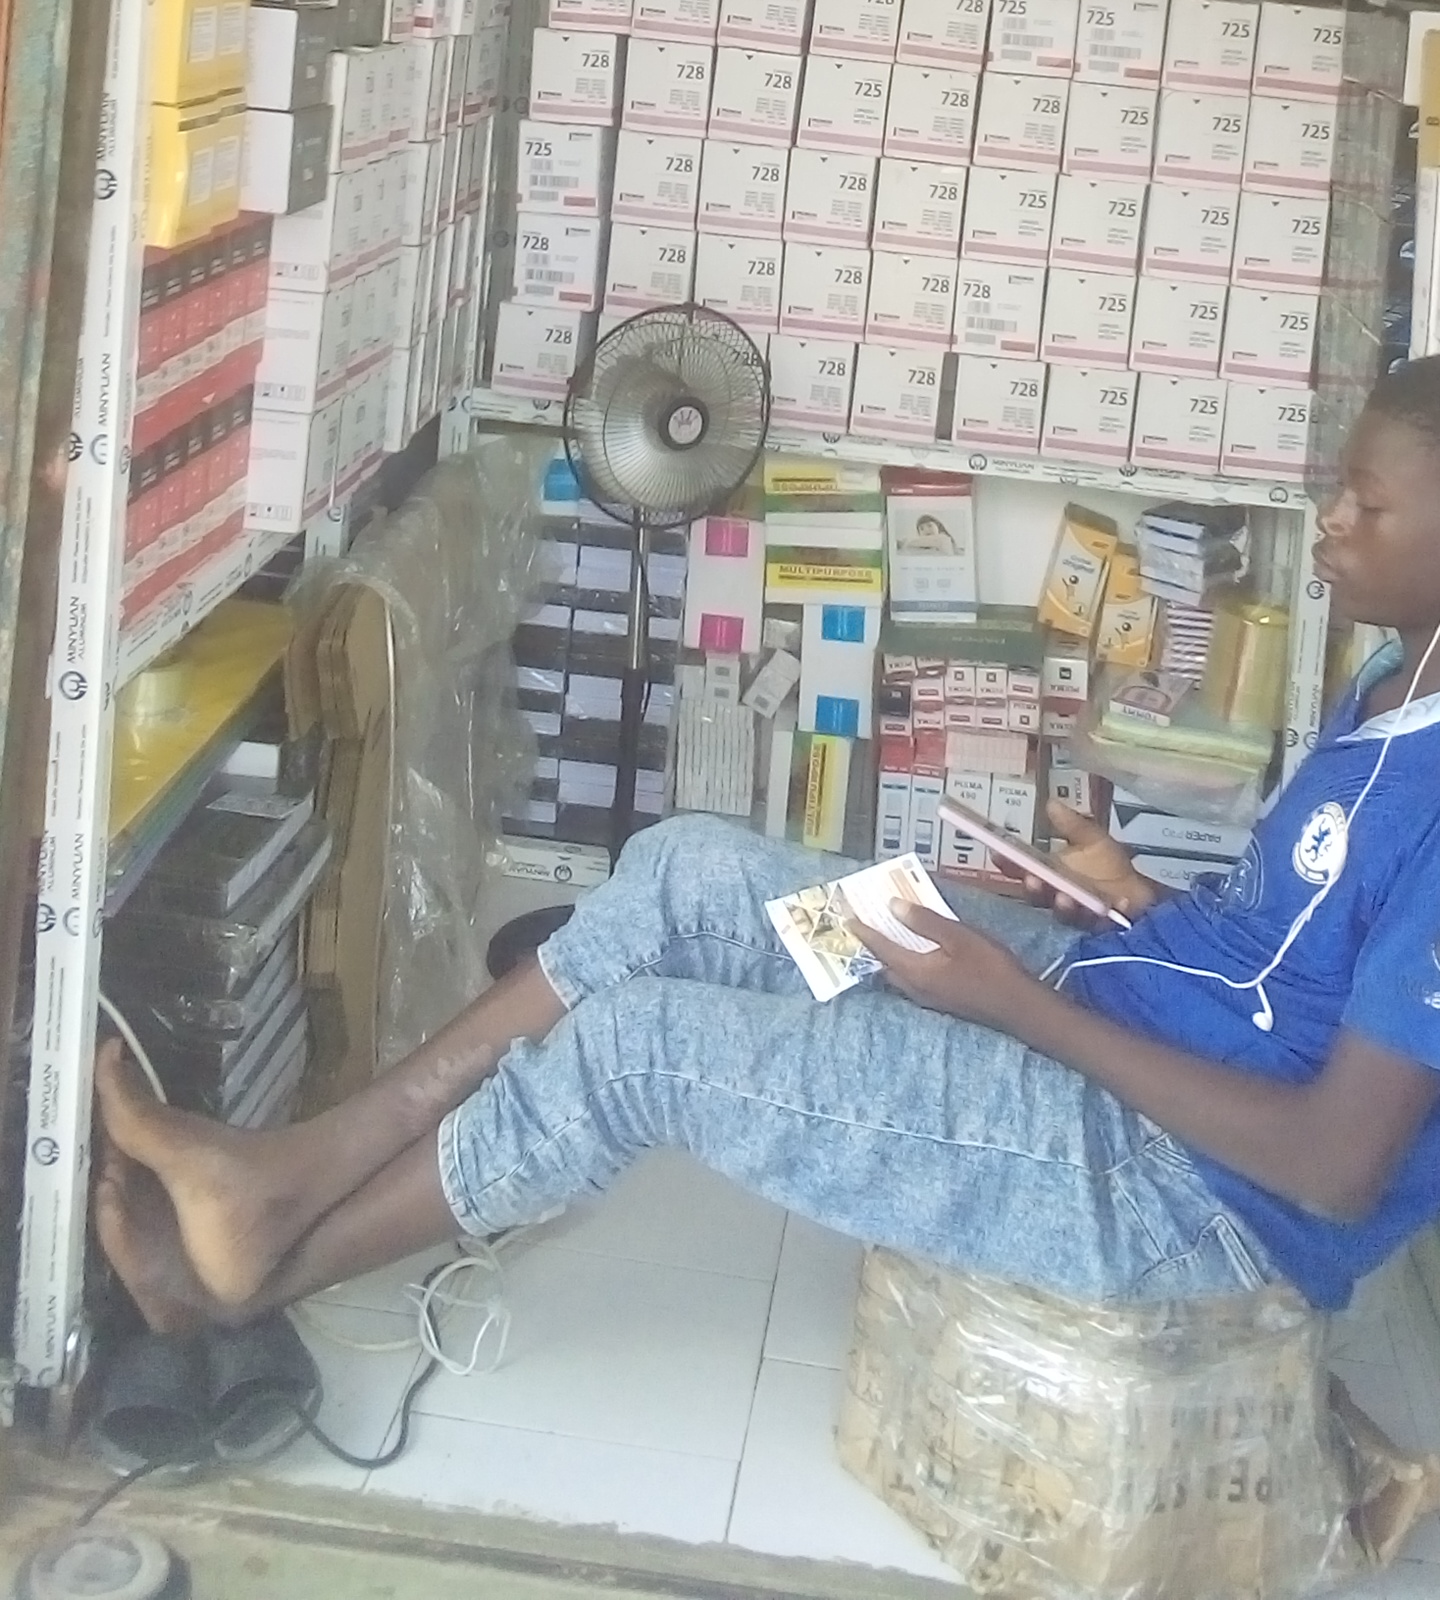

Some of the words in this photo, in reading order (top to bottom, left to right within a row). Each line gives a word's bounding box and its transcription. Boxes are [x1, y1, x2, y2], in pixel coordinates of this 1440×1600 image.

[998, 0, 1027, 15] 725
[1087, 9, 1115, 27] 725
[1222, 21, 1250, 38] 725
[1313, 27, 1342, 45] 725
[581, 52, 610, 69] 728
[676, 63, 705, 80] 728
[764, 72, 792, 90] 728
[854, 81, 882, 98] 725
[941, 90, 970, 108] 728
[1032, 97, 1061, 114] 728
[1120, 109, 1149, 126] 725
[1212, 116, 1241, 134] 725
[1302, 123, 1330, 140] 725
[525, 141, 552, 157] 725
[666, 156, 693, 173] 728
[752, 165, 780, 182] 728
[839, 174, 867, 192] 728
[929, 184, 958, 201] 728
[1019, 192, 1048, 209] 725
[1108, 200, 1137, 218] 725
[1201, 209, 1230, 226] 725
[1292, 218, 1321, 236] 725
[522, 234, 550, 251] 728
[658, 247, 686, 264] 728
[748, 260, 776, 276] 728
[835, 268, 863, 285] 728
[921, 276, 950, 294] 728
[963, 282, 991, 299] 728
[1098, 296, 1127, 313] 725
[1190, 303, 1219, 321] 725
[1280, 314, 1309, 331] 725
[545, 328, 573, 345] 728
[818, 360, 846, 377] 728
[908, 369, 936, 386] 728
[98, 353, 111, 426] MINYUAN
[1010, 381, 1038, 398] 728
[1099, 389, 1128, 406] 725
[1190, 398, 1219, 415] 725
[1278, 406, 1307, 423] 725
[779, 565, 873, 578] MULTIPURPOSE
[66, 596, 80, 664] MINYUAN
[954, 779, 984, 791] PIXMA
[999, 786, 1029, 798] PIXMA
[72, 833, 84, 899] MINYUAN
[40, 1063, 52, 1130] MINYUAN
